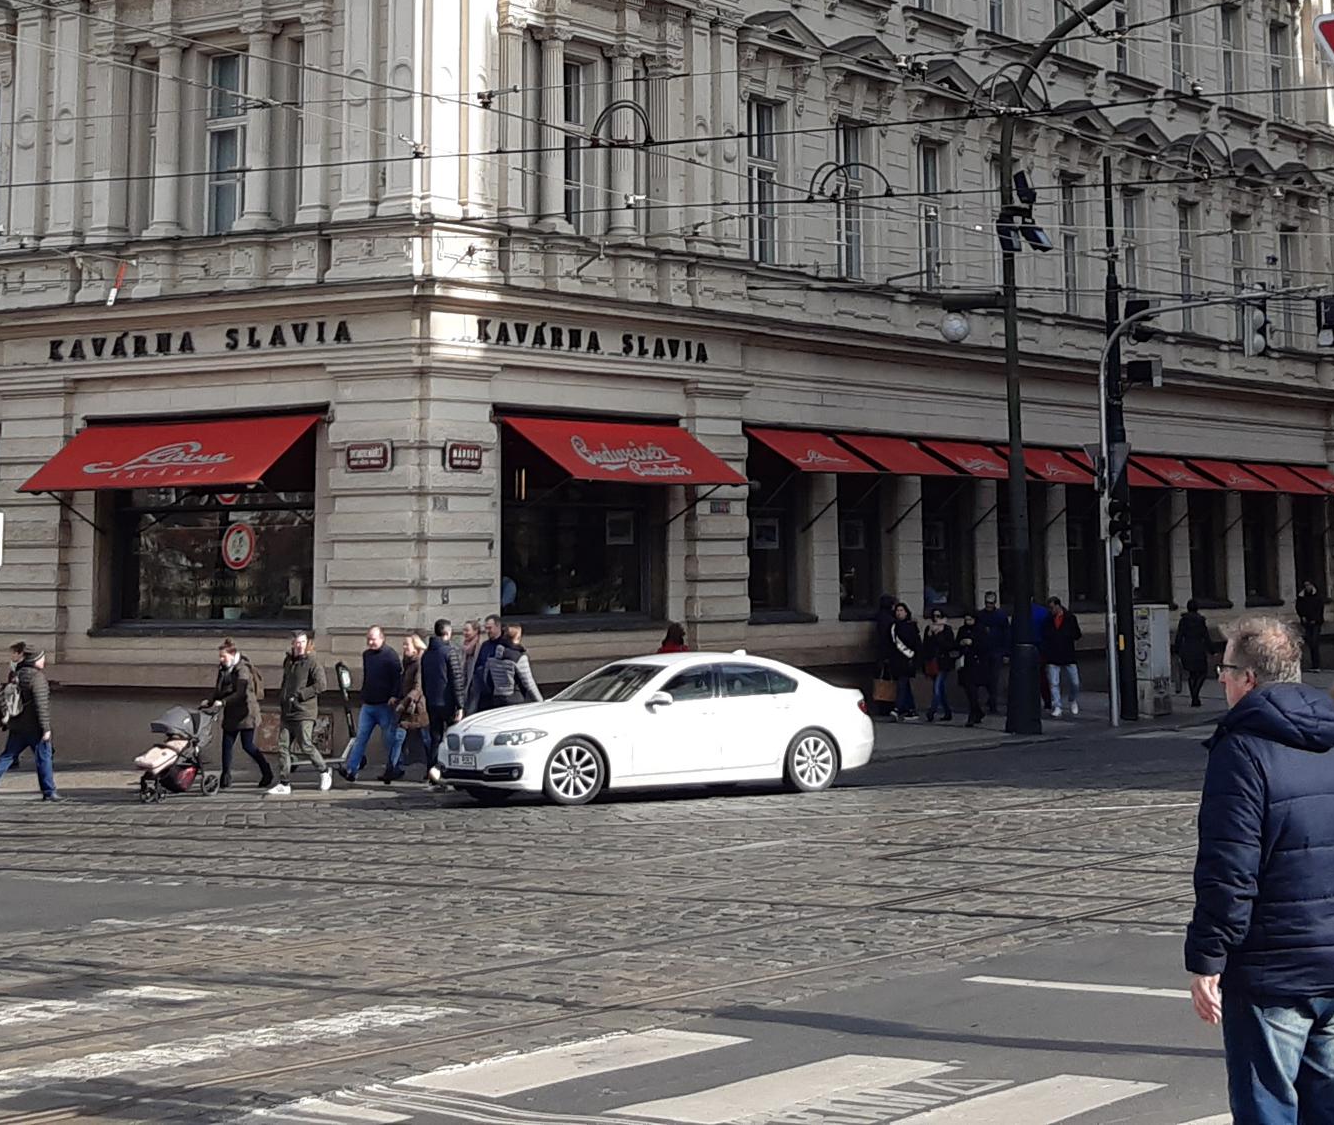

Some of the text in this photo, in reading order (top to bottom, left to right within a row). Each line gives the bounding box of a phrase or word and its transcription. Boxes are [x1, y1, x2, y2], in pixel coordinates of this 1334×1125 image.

[49, 320, 352, 361] KAVÁRNA SLAVIA
[477, 318, 708, 363] KAVÁRNA SLAVIA
